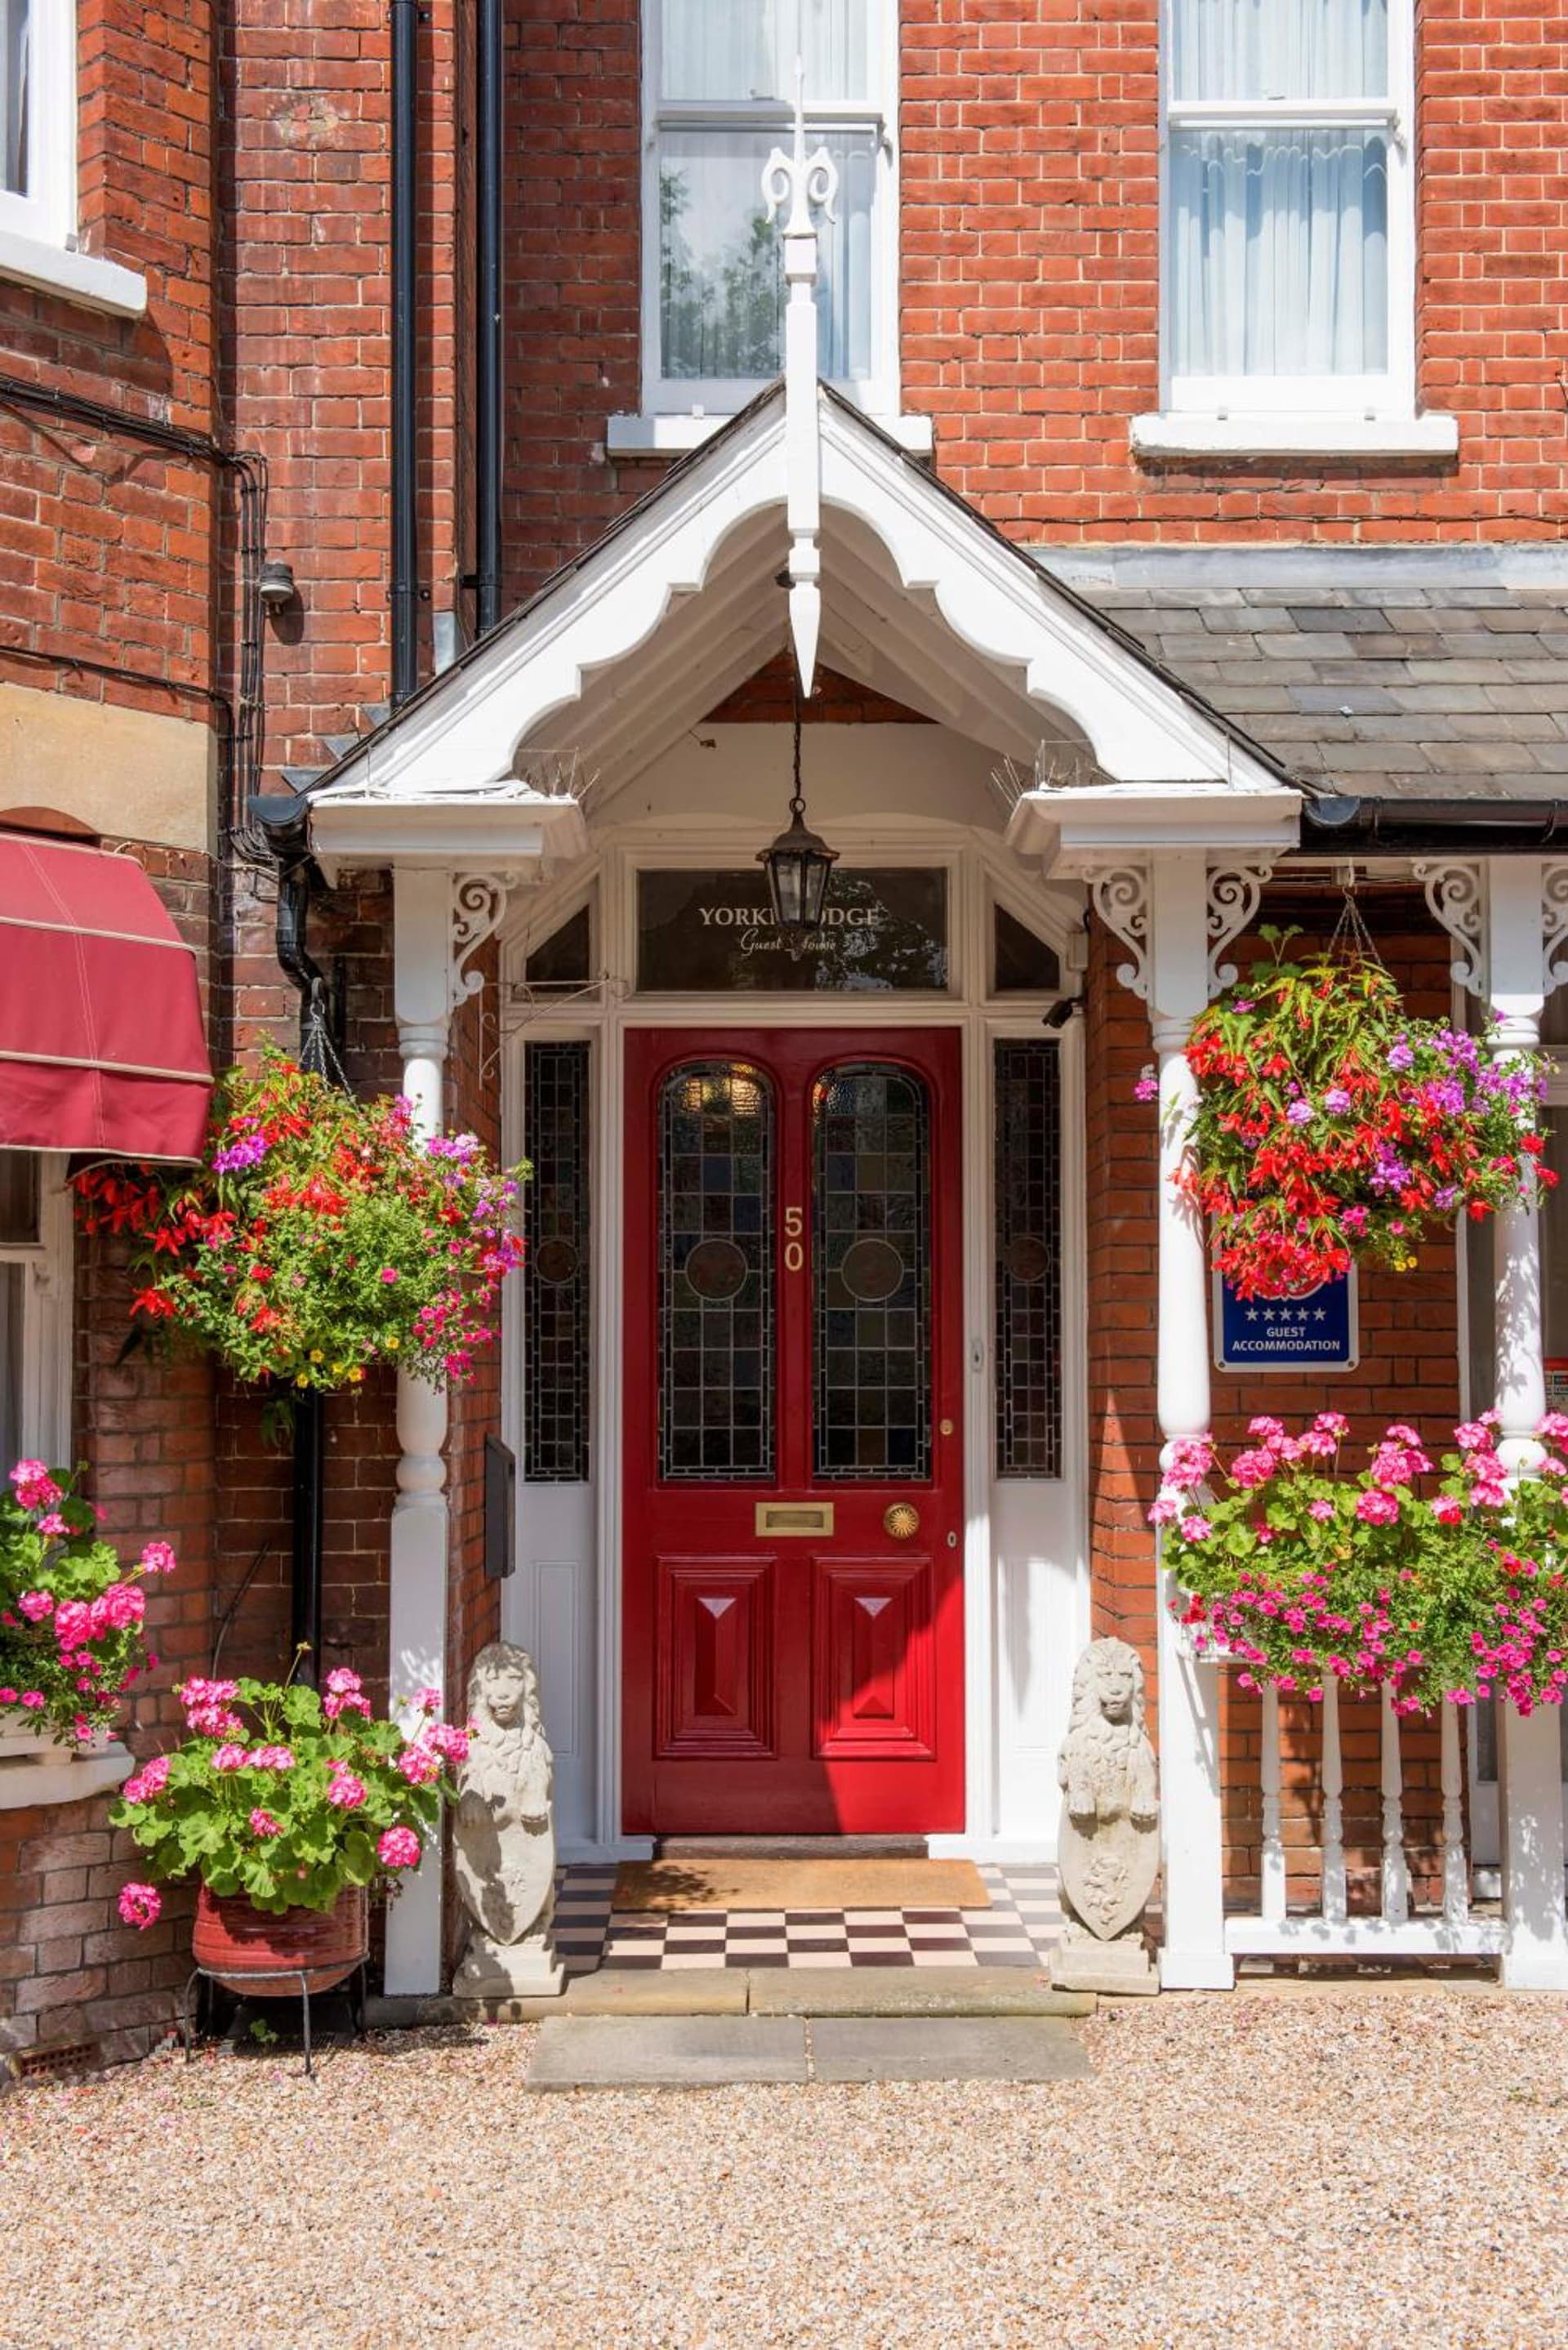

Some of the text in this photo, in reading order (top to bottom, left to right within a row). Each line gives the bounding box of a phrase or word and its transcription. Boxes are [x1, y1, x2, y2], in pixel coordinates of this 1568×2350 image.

[819, 907, 880, 926] DGE
[740, 927, 782, 956] Guest
[1267, 1327, 1307, 1337] GUEST
[1232, 1340, 1341, 1352] ACCOMMODATION
